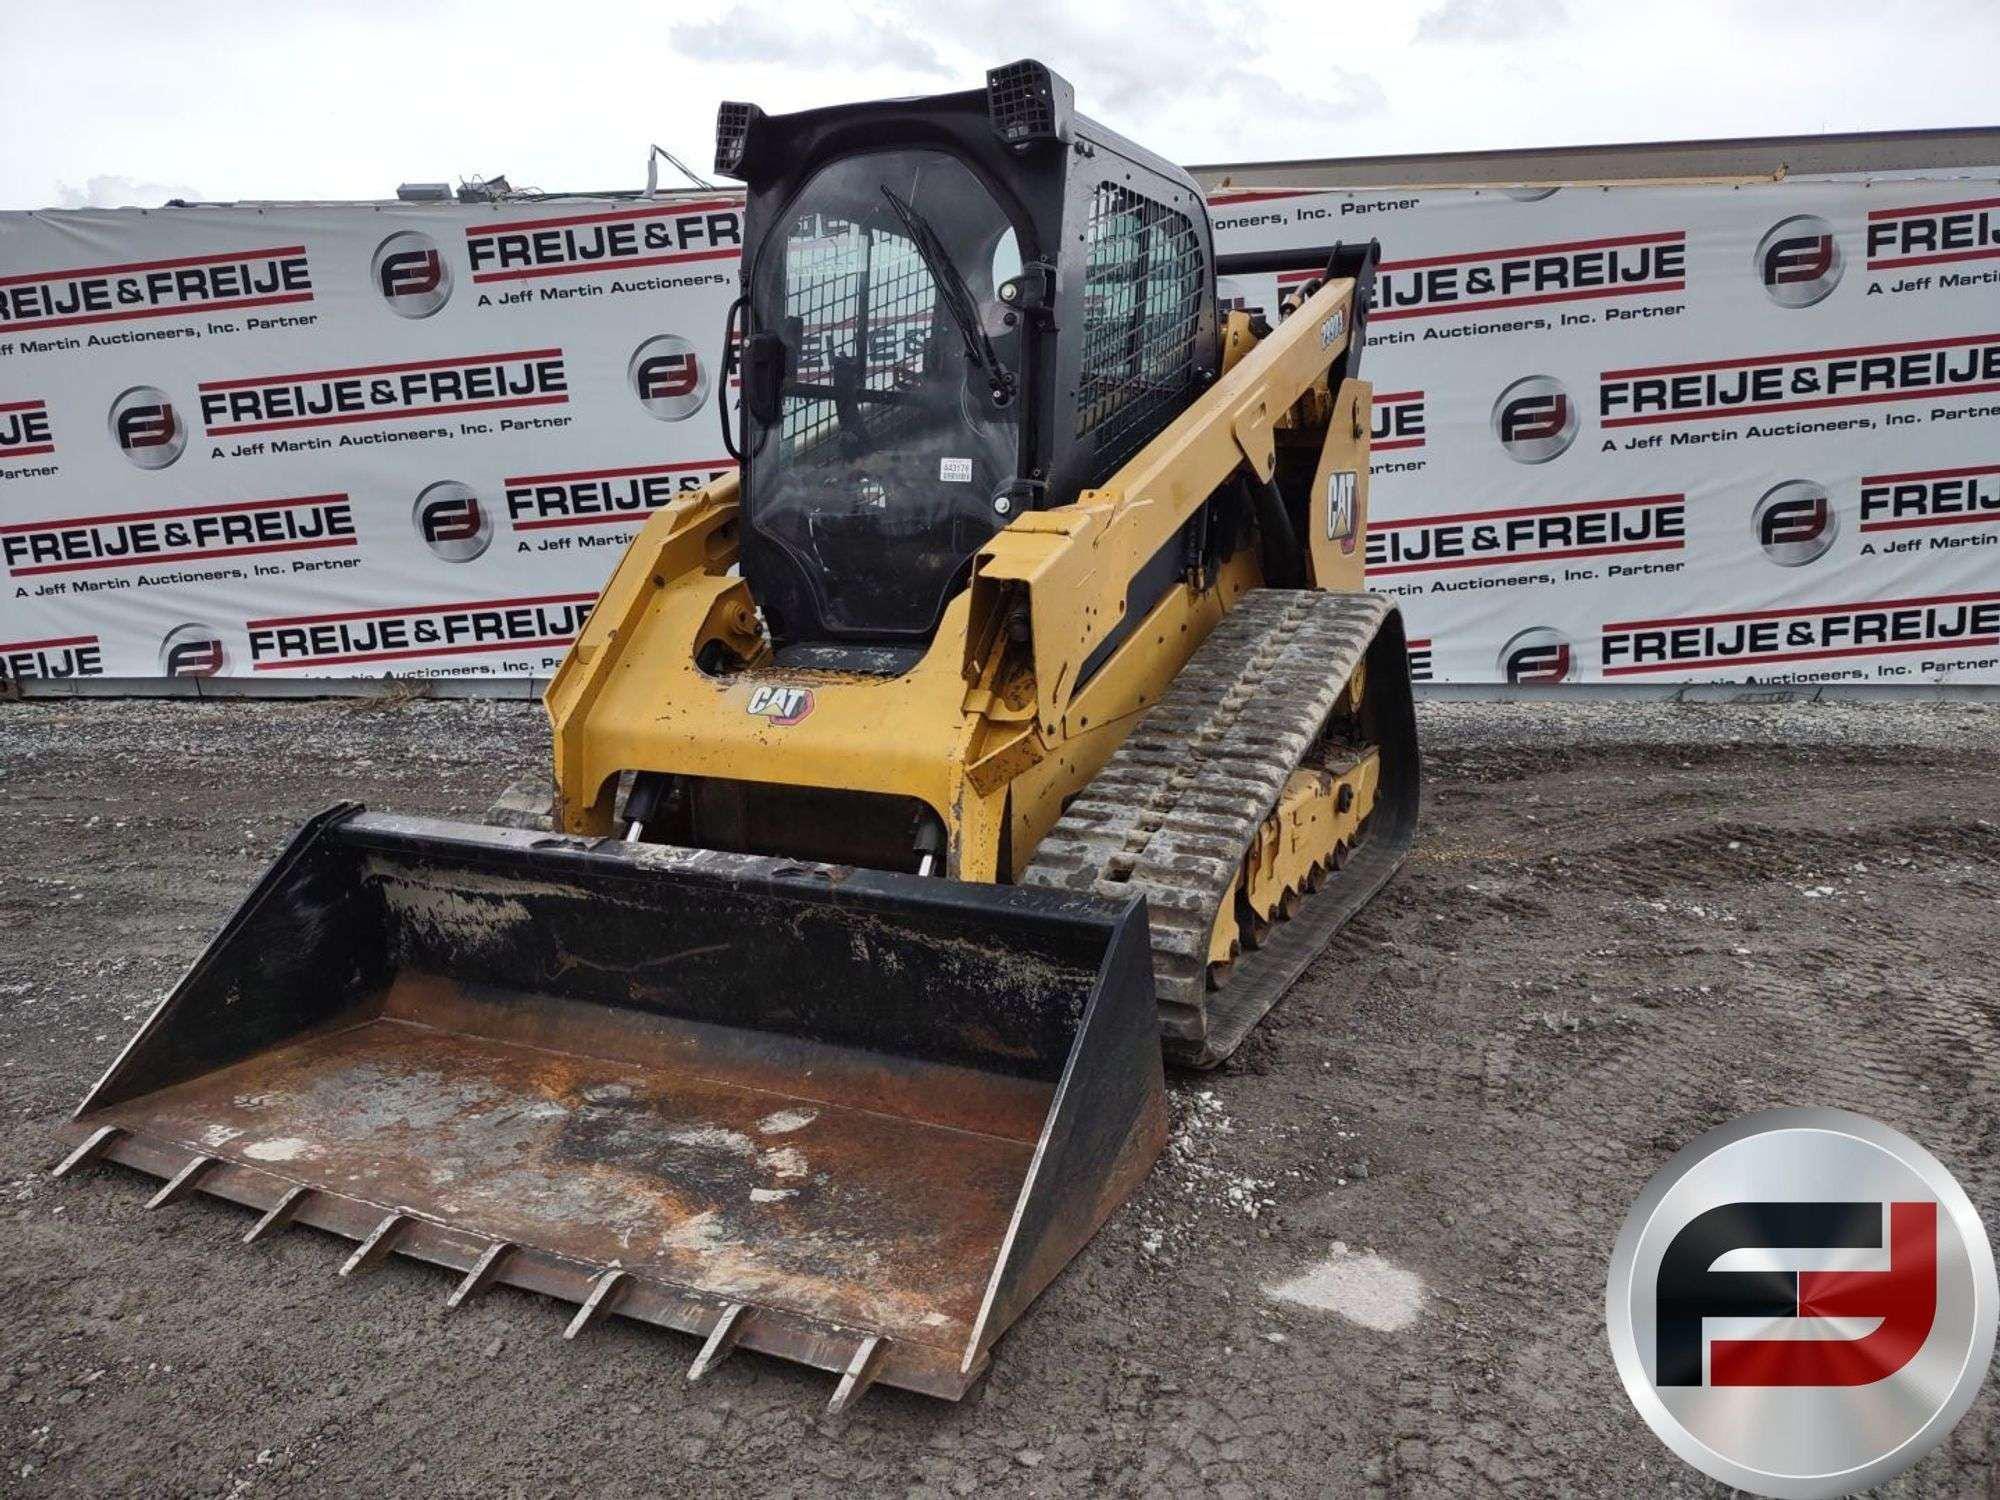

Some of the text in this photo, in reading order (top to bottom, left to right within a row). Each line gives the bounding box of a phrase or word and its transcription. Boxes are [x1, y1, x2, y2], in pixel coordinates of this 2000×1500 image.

[1297, 209, 1331, 220] Inc.
[1341, 199, 1419, 215] Partner
[465, 223, 638, 271] FREIJE
[645, 223, 673, 249] &
[1867, 212, 2000, 258] FREI
[117, 278, 144, 304] &
[146, 257, 314, 305] FREIJE
[1466, 267, 1495, 294] &
[1502, 244, 1685, 295] FREIJE
[1867, 270, 2000, 295] A Jeff Marti
[478, 274, 730, 306] A Jeff Martin Auctioneers,
[20, 338, 80, 353] Martin
[88, 328, 201, 347] Auctioneers,
[208, 323, 239, 334] Inc.
[247, 315, 317, 330] Partner
[1423, 320, 1551, 340] Auctioneers,
[1561, 314, 1595, 325] Inc.
[1606, 306, 1685, 321] Partner
[200, 360, 569, 425] FREIJE & FREIJE
[1600, 368, 1783, 416] FREIJE
[1791, 367, 1821, 394] &
[212, 417, 571, 459] A Jeff Martin Auctioneers, Inc. Partner
[1602, 440, 1617, 452] A
[1625, 435, 1662, 449] Jeff
[1671, 429, 1737, 445] Martin
[1746, 419, 1876, 438] Auctioneers,
[1886, 414, 1921, 425] Inc.
[506, 476, 672, 519] FREIJE
[1328, 472, 1356, 540] CAT
[2, 505, 355, 566] FREIJE & FREIJE
[518, 542, 531, 553] A
[538, 538, 571, 551] Jeff
[1472, 526, 1500, 551] &
[1506, 506, 1685, 551] FREIJE
[1860, 534, 1998, 555] A Jeff Martin
[16, 559, 361, 598] A Jeff Martin Auctioneers, Inc. Partner
[1431, 575, 1555, 592] Auctioneers,
[1565, 570, 1598, 581] Inc.
[1608, 563, 1684, 577] Partner
[249, 620, 409, 659] FREIJE
[414, 620, 441, 642] &
[1602, 603, 2000, 665] FREIJE & FREIJE
[0, 647, 103, 679] EIJE
[503, 661, 535, 673] Inc.
[1878, 666, 1911, 676] Inc.
[1922, 659, 1998, 673] Partner
[747, 686, 806, 717] CAT
